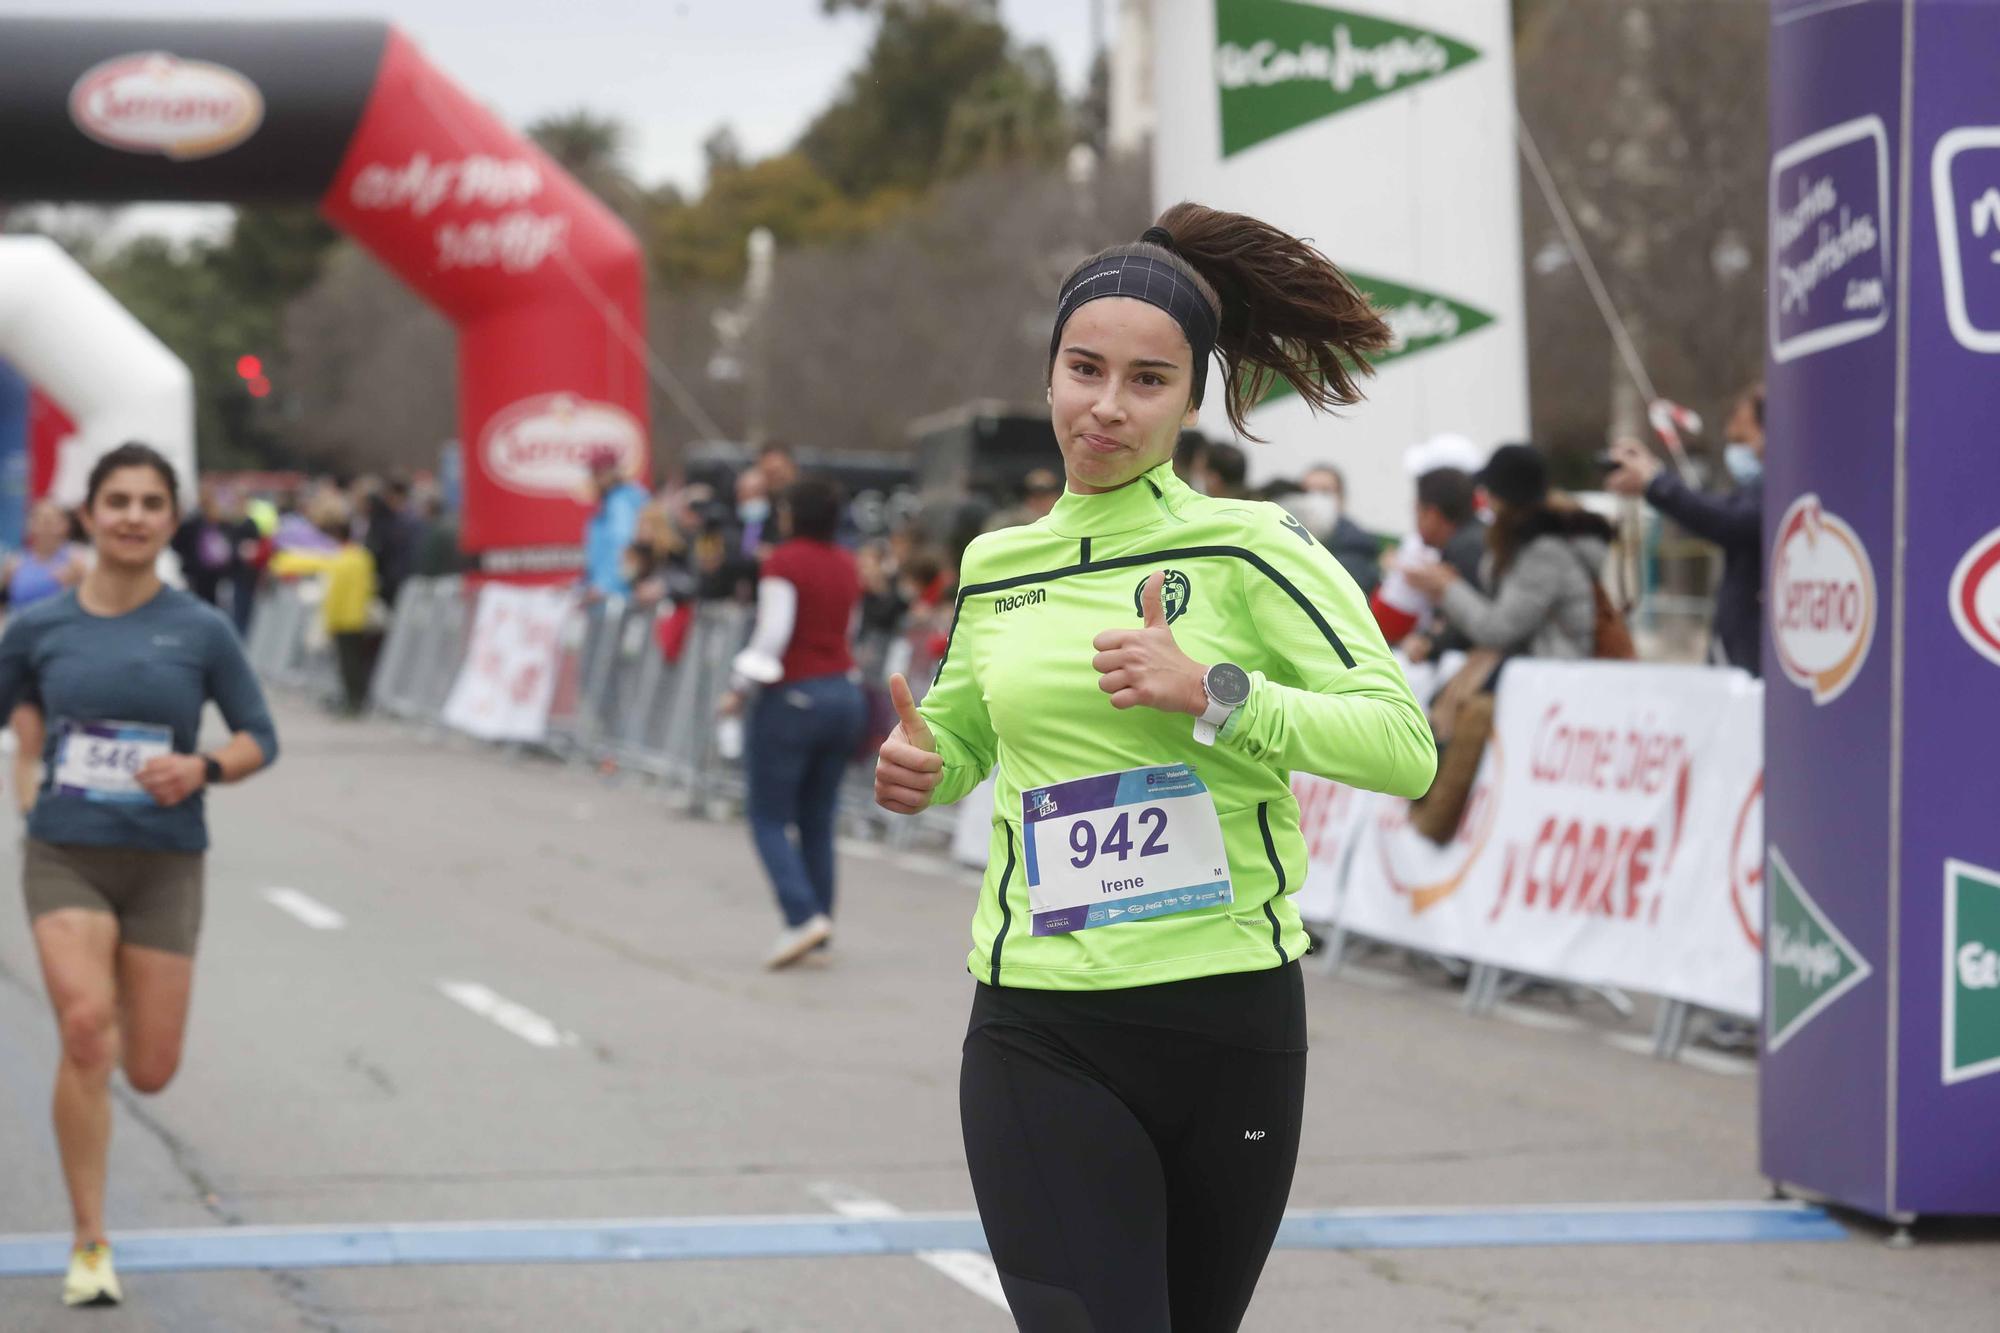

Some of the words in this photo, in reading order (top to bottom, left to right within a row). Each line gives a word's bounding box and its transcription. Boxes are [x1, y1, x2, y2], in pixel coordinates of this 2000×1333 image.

[994, 588, 1046, 614] macron
[1041, 801, 1057, 816] FEM
[1069, 806, 1169, 869] 942
[1214, 867, 1223, 877] M
[1101, 875, 1145, 895] Irene
[1244, 1130, 1266, 1141] MP
